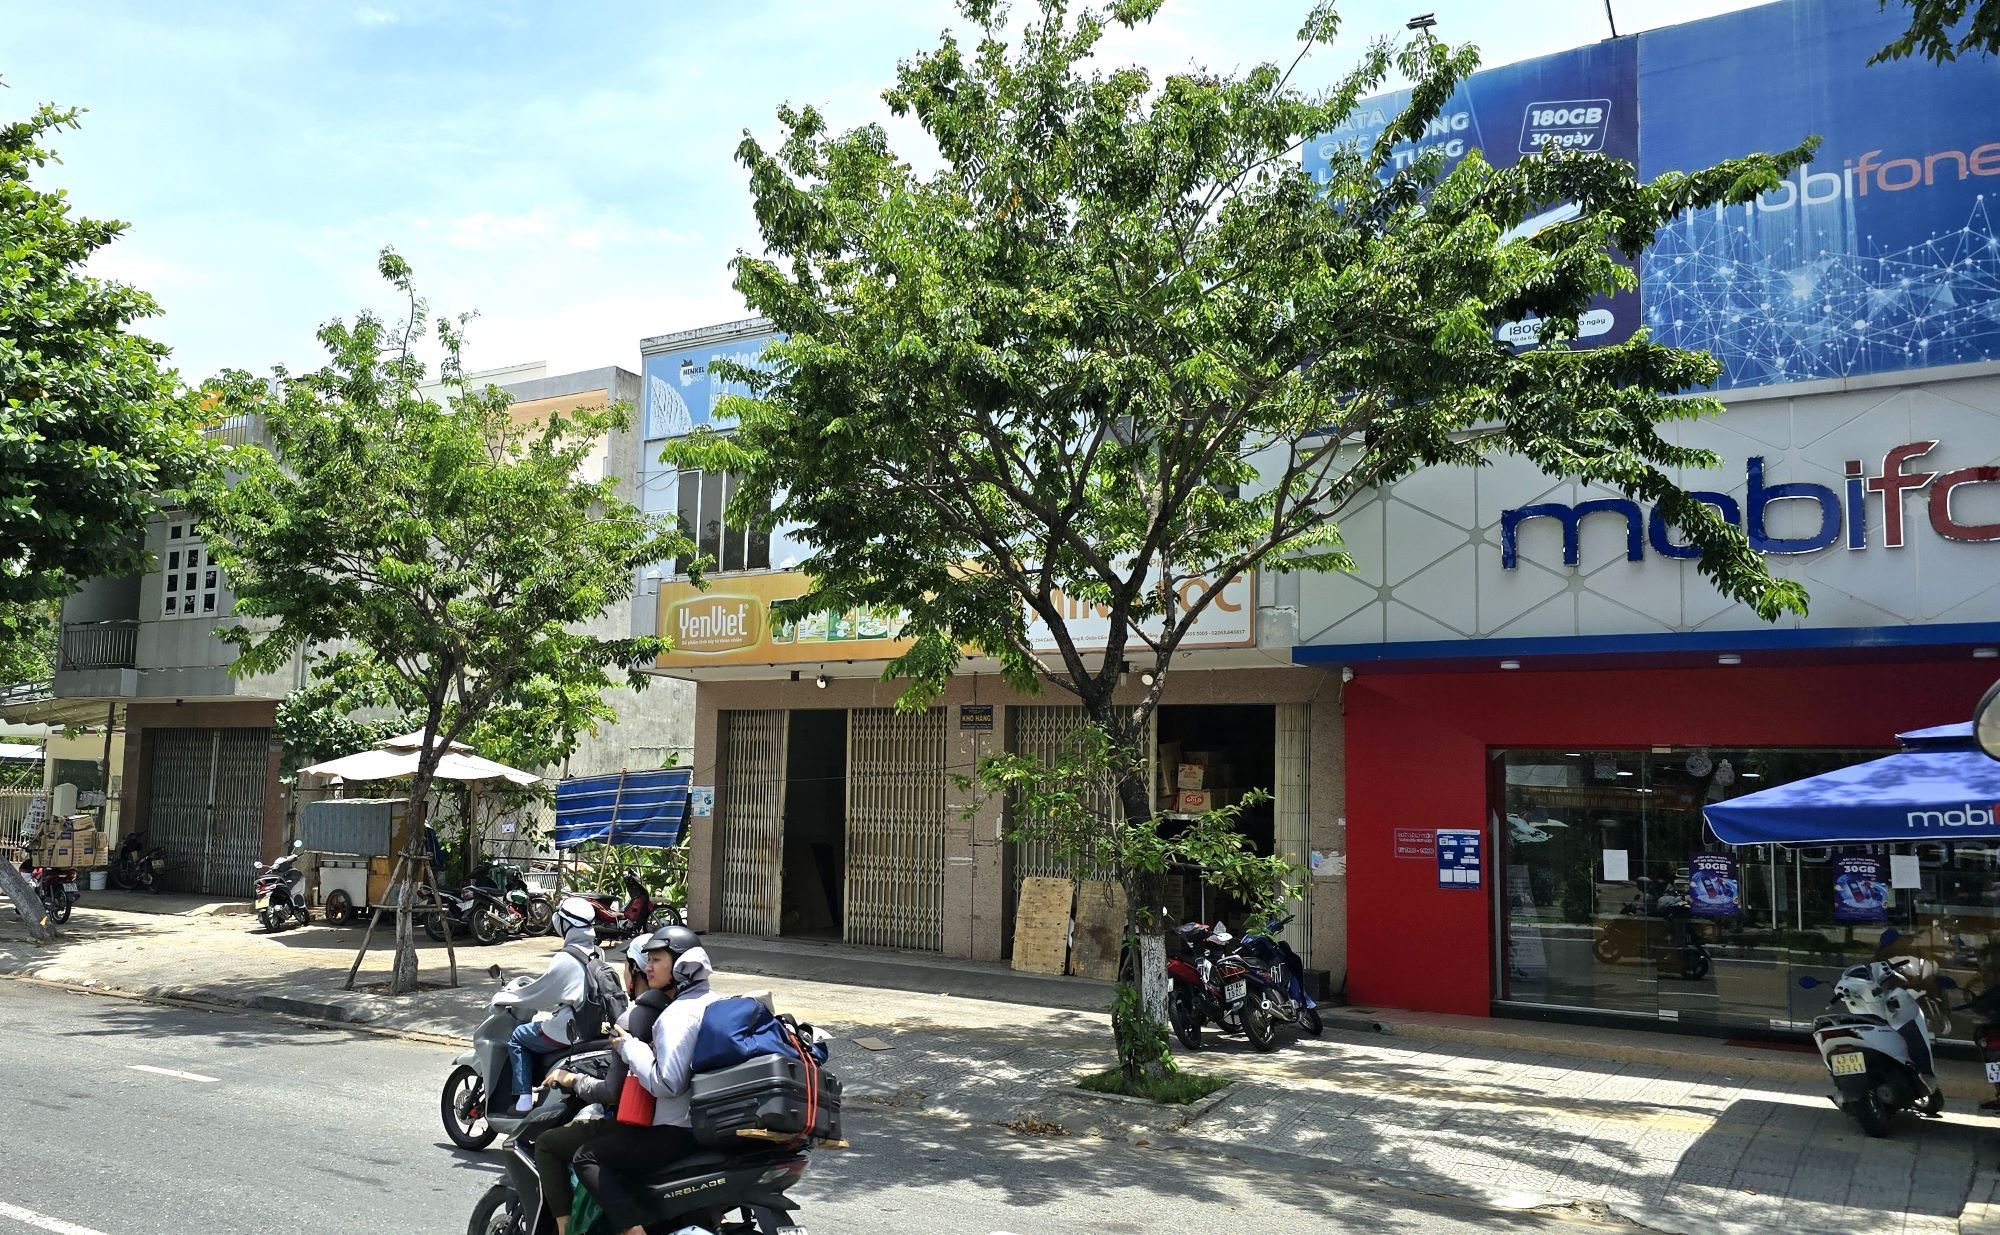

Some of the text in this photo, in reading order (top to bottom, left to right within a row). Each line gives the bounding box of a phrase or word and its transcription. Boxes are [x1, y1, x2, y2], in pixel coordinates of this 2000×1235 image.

[1531, 107, 1602, 126] 180GB
[1530, 132, 1594, 147] 30 ngày
[1686, 142, 2000, 226] obifone
[1586, 318, 1606, 326] ngày
[683, 366, 705, 376] HENKEL
[679, 604, 748, 639] YenViet
[1698, 862, 1728, 871] 30GB
[1843, 865, 1876, 873] 30GB
[664, 1177, 727, 1199] AIRBLADE
